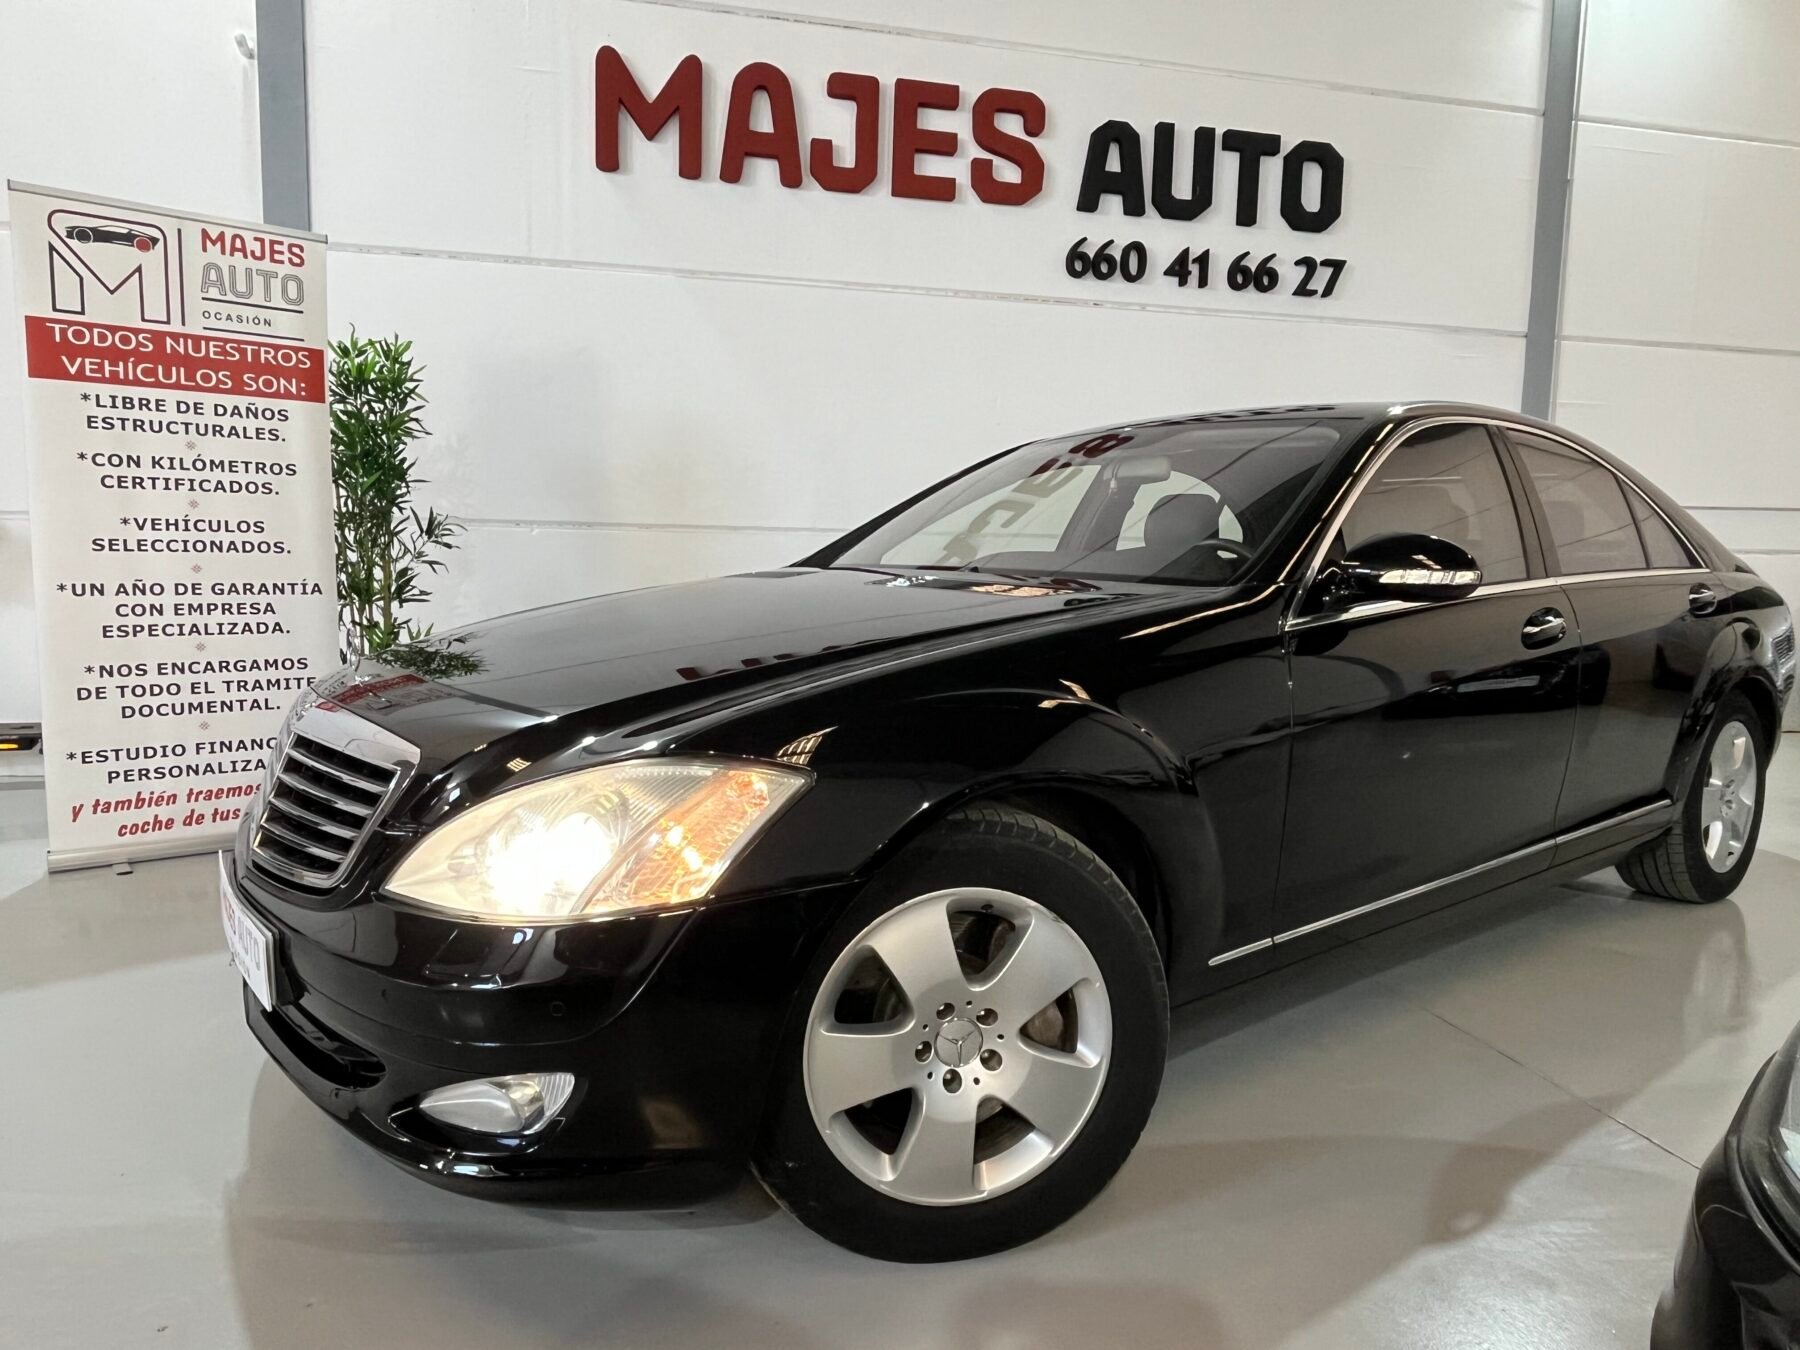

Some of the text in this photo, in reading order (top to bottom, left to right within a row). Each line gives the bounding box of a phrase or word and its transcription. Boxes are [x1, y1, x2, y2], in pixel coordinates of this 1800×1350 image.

[595, 45, 1344, 233] MAJES AUTO
[201, 228, 305, 268] MAJES
[1065, 236, 1348, 298] 660 41 66 27
[200, 262, 305, 306] AUTO
[202, 310, 272, 327] OCASIÓN
[46, 323, 311, 369] TODOS NUESTROS
[61, 355, 306, 396] VEHÍCULOS SON:
[176, 401, 205, 415] DE
[213, 402, 290, 422] DAÑOS
[86, 415, 287, 442] ESTRUCTURALES.
[151, 454, 297, 477] KILÓMETROS
[100, 475, 280, 495] CERTIFICADOS.
[91, 538, 292, 555] SELECCIONADOS.
[115, 579, 165, 597] AÑO
[174, 583, 203, 596] DE
[210, 579, 323, 597] GARANTÍA
[115, 602, 276, 617] CON EMPRESA
[102, 622, 291, 639] ESPECIALIZADA.
[157, 657, 309, 676] ENCARGAMOS
[77, 686, 107, 700] DE
[115, 682, 181, 699] TODO
[190, 680, 216, 695] EL
[121, 698, 281, 719] DOCUMENTAL.
[195, 737, 277, 755] FINANC
[107, 758, 267, 784] PERSONALIZA
[71, 803, 85, 822] y
[92, 790, 178, 815] también
[117, 807, 241, 838] coche de tus
